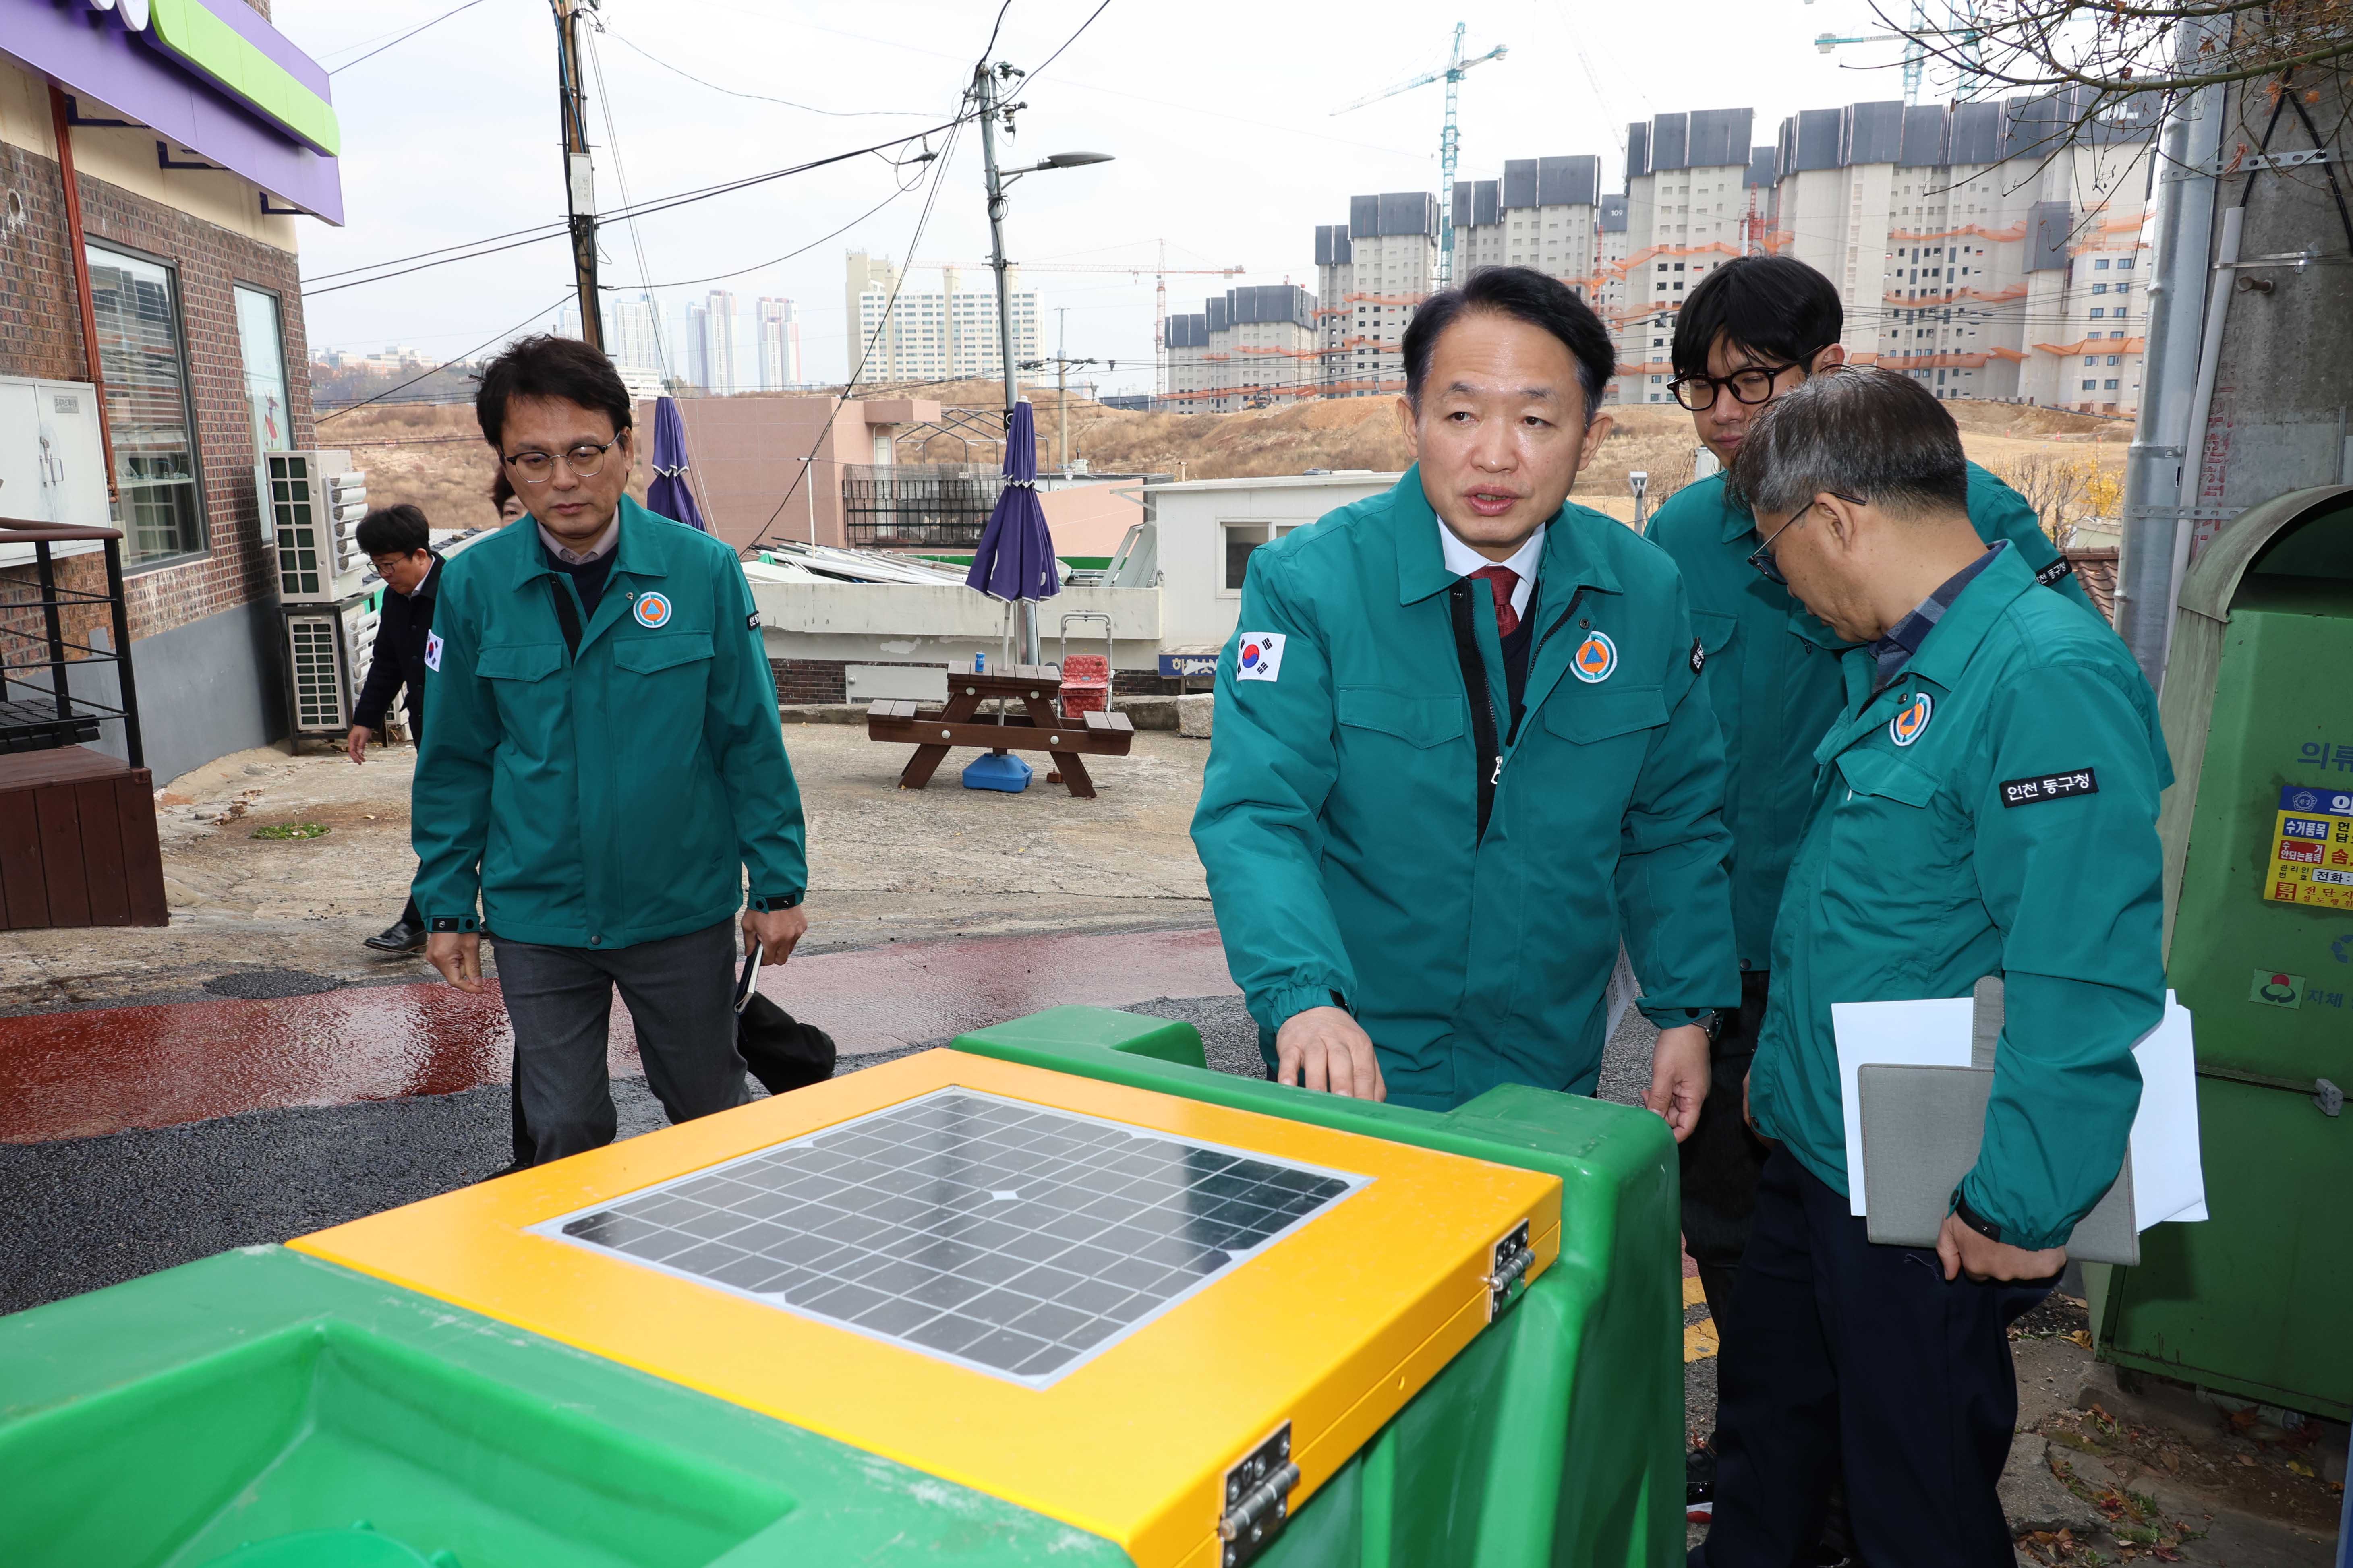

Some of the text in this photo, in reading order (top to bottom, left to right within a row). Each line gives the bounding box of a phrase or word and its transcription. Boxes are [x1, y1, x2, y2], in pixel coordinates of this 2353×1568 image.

[2048, 561, 2066, 579] 동구청
[2007, 773, 2089, 801] 인천 동구청
[2286, 821, 2350, 837] 수거품목 헌
[2281, 850, 2322, 863] 안되는품목
